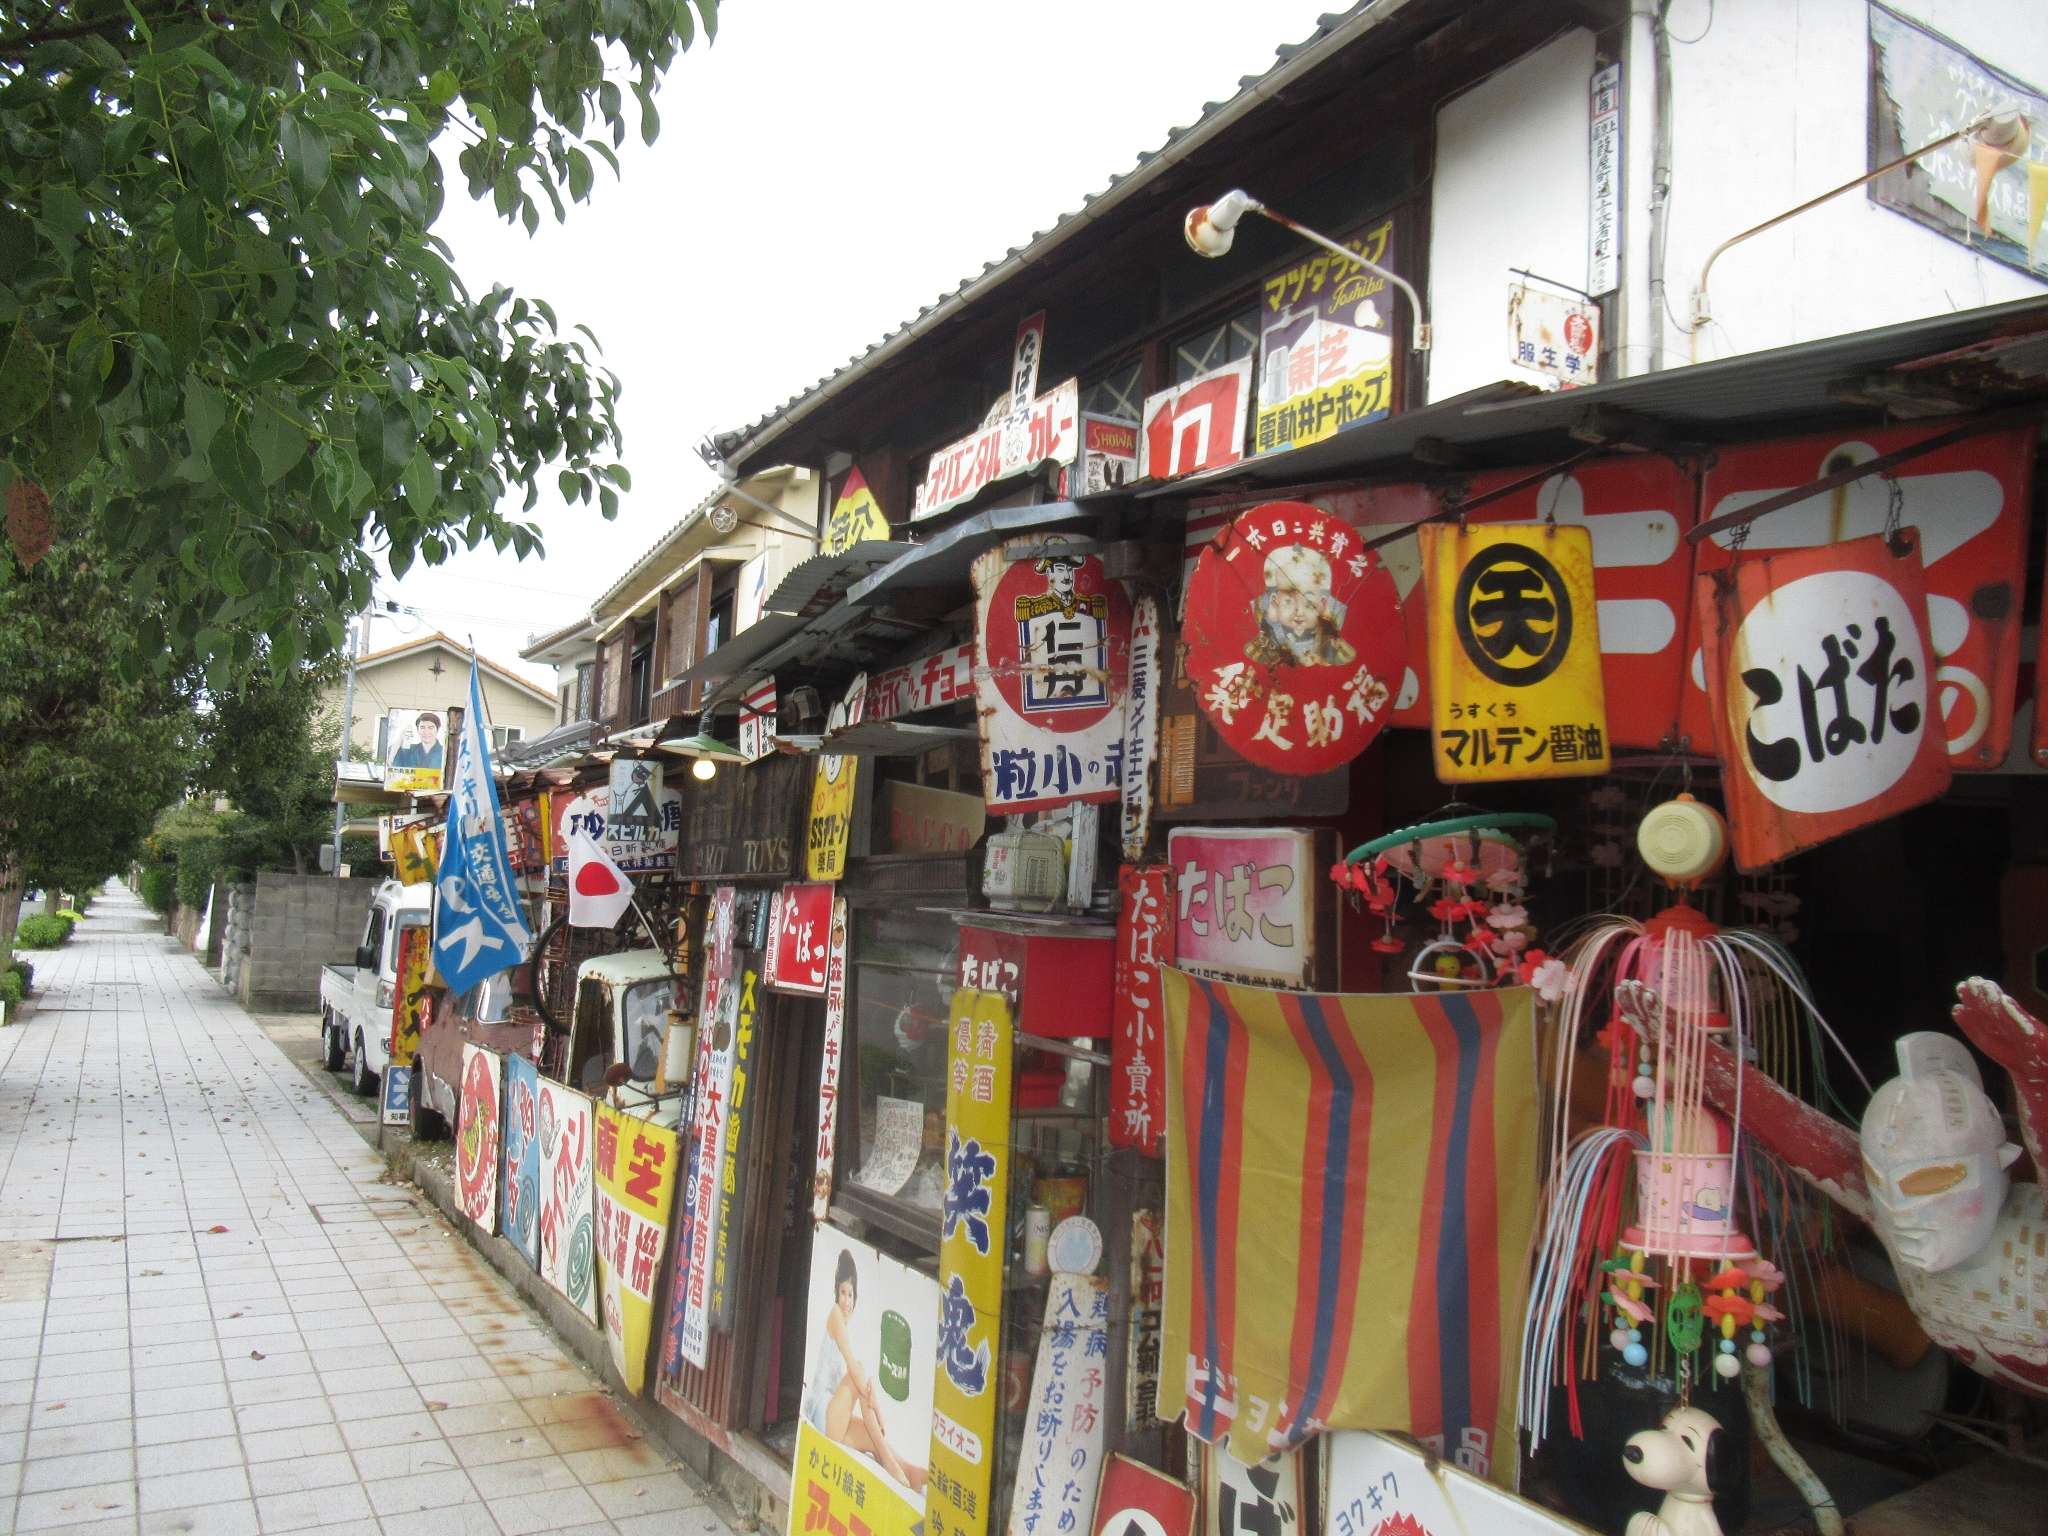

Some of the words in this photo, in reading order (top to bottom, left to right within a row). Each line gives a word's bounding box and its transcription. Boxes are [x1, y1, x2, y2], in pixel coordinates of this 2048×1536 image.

[1264, 220, 1392, 309] マツダランプ
[1330, 276, 1385, 314] Toshiba
[1286, 329, 1349, 397] 東芝
[1091, 425, 1135, 451] SHOWA
[1258, 371, 1388, 452] 電動井戸ポンプ
[926, 431, 1001, 508] オリエンタル
[1027, 404, 1073, 464] カレー
[1440, 722, 1604, 769] マルテン醤油
[1448, 702, 1518, 719] うすくち
[743, 839, 791, 873] TOYS
[783, 890, 826, 983] たばこ
[1176, 861, 1295, 948] たばこ
[961, 953, 1020, 1003] たばこ
[1123, 878, 1162, 1147] たばこ小賣所
[951, 1016, 972, 1095] 優等
[972, 1020, 998, 1103] 清酒
[541, 1110, 586, 1267] ライオン
[595, 1115, 667, 1208] 東芝
[595, 1186, 660, 1298] 洗濯機
[1021, 1288, 1081, 1535] 入場をお断りします
[808, 1447, 866, 1510] かとり線香
